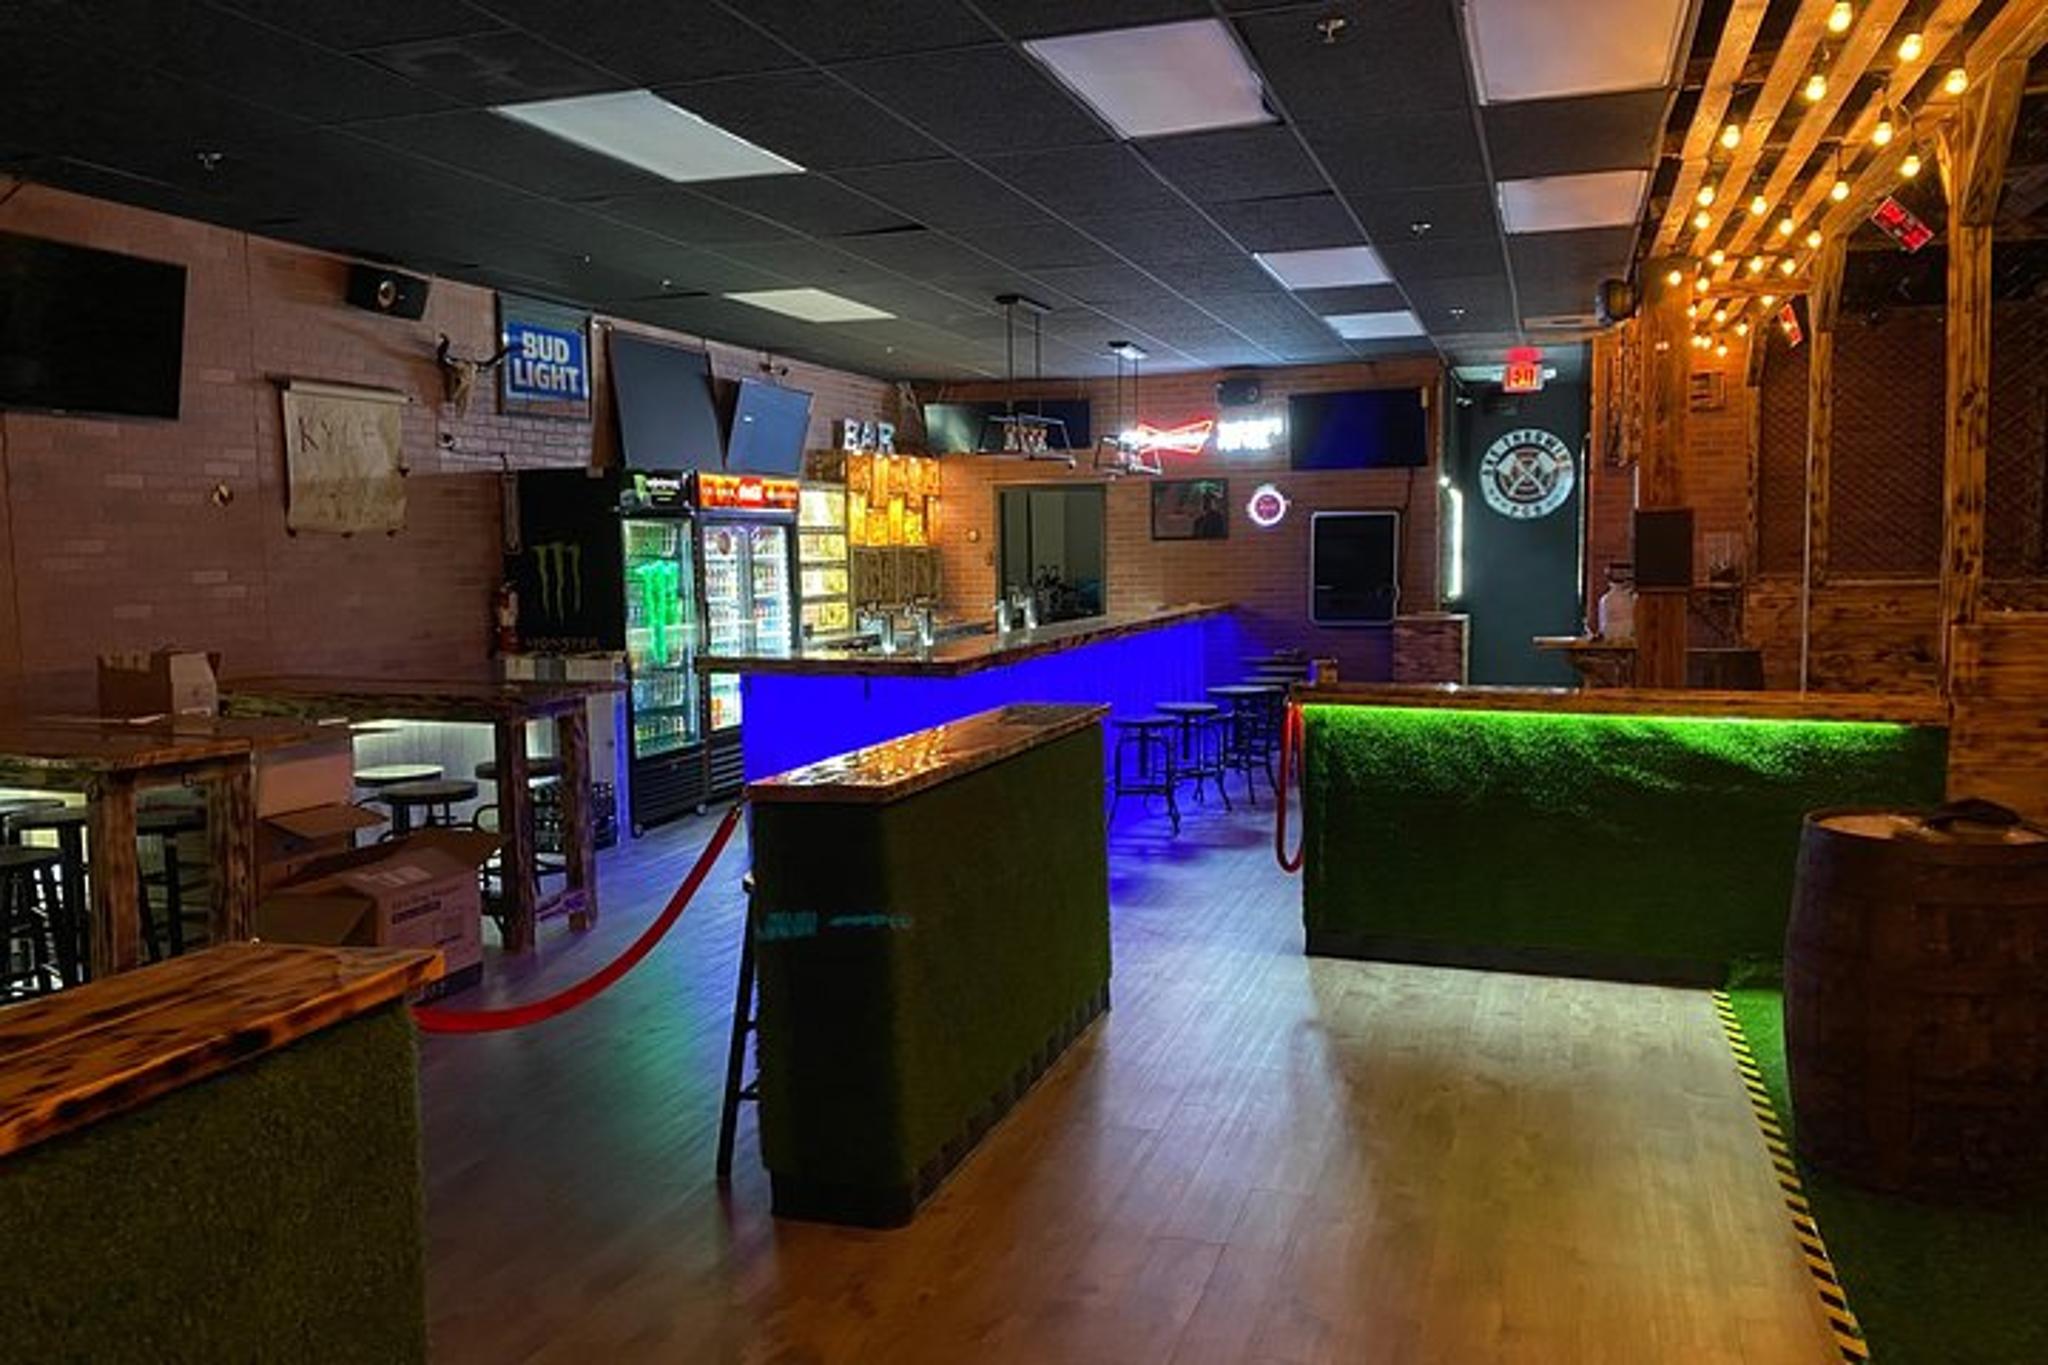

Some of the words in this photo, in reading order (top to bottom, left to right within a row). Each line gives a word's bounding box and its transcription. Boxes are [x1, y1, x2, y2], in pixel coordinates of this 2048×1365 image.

[522, 330, 570, 364] BUD
[513, 358, 579, 392] LIGHT
[843, 418, 896, 454] BAR
